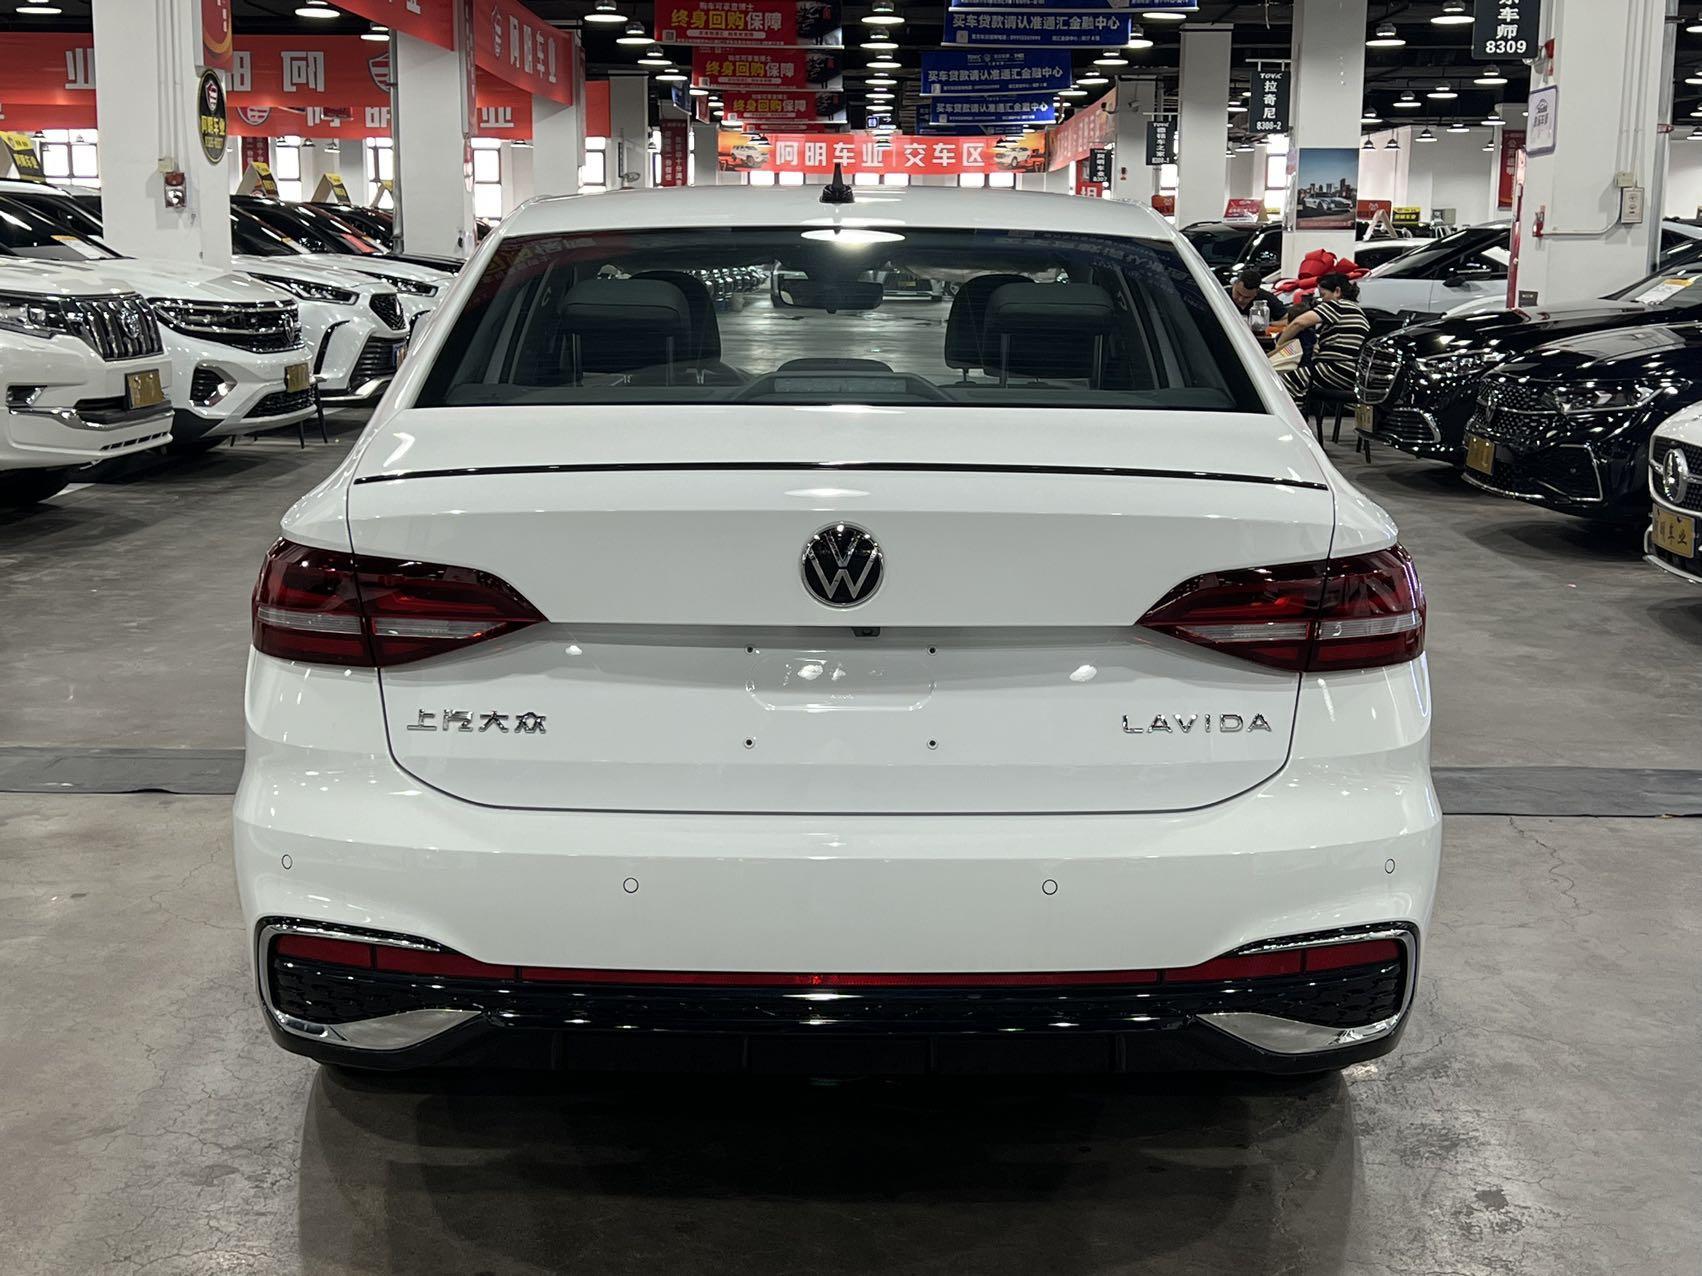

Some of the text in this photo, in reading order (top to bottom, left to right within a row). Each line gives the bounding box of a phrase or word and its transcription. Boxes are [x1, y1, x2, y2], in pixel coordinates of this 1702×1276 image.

[671, 9, 782, 31] 终身回购保障
[1485, 40, 1527, 53] 8309
[1263, 80, 1277, 119] 拉奇尼
[776, 141, 985, 168] 阿明车业 交车区
[406, 708, 547, 734] 上汽大众
[1122, 713, 1272, 733] LAVIDA
